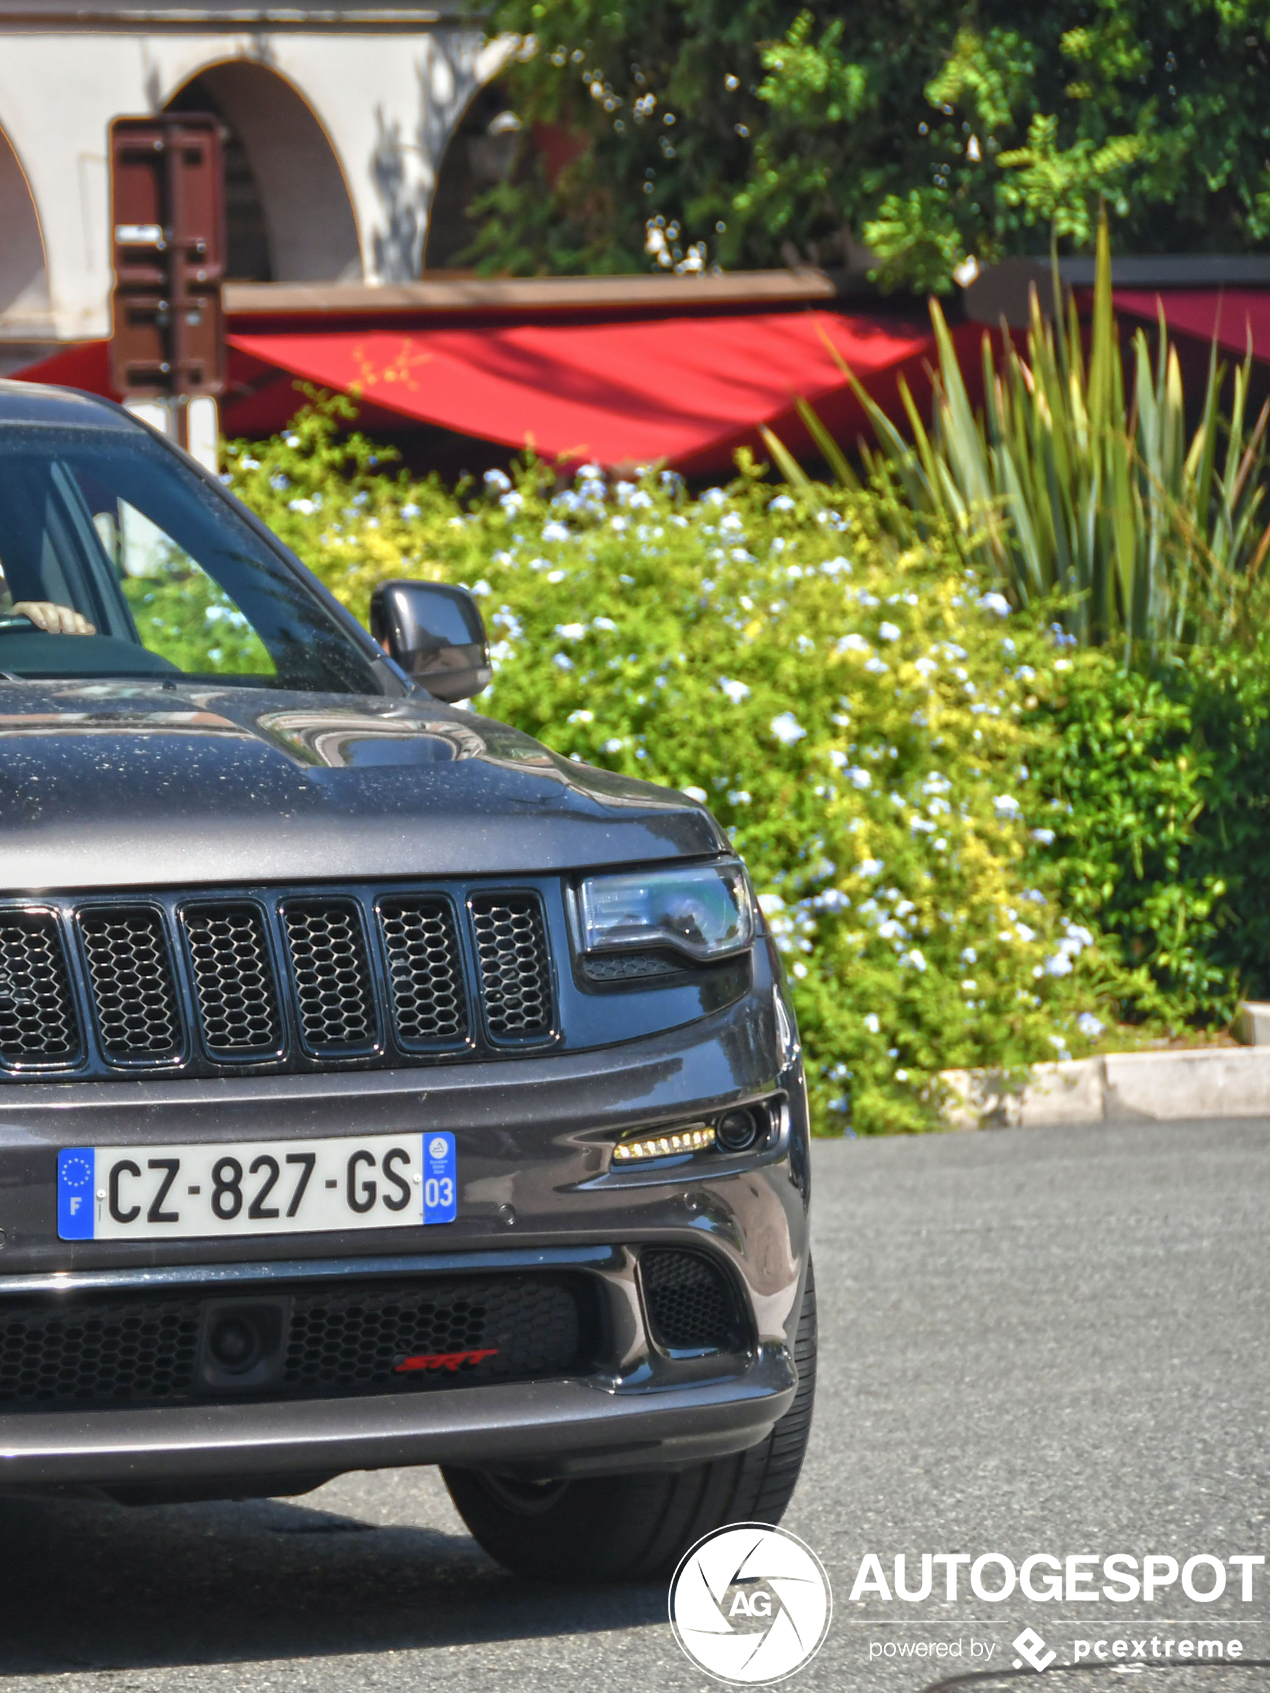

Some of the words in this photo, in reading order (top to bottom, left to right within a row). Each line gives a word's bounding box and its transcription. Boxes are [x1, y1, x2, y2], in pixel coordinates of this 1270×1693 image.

[109, 1148, 411, 1223] CZ-827-GS
[425, 1177, 453, 1207] 03
[70, 1197, 82, 1216] F
[396, 1349, 498, 1371] SRT
